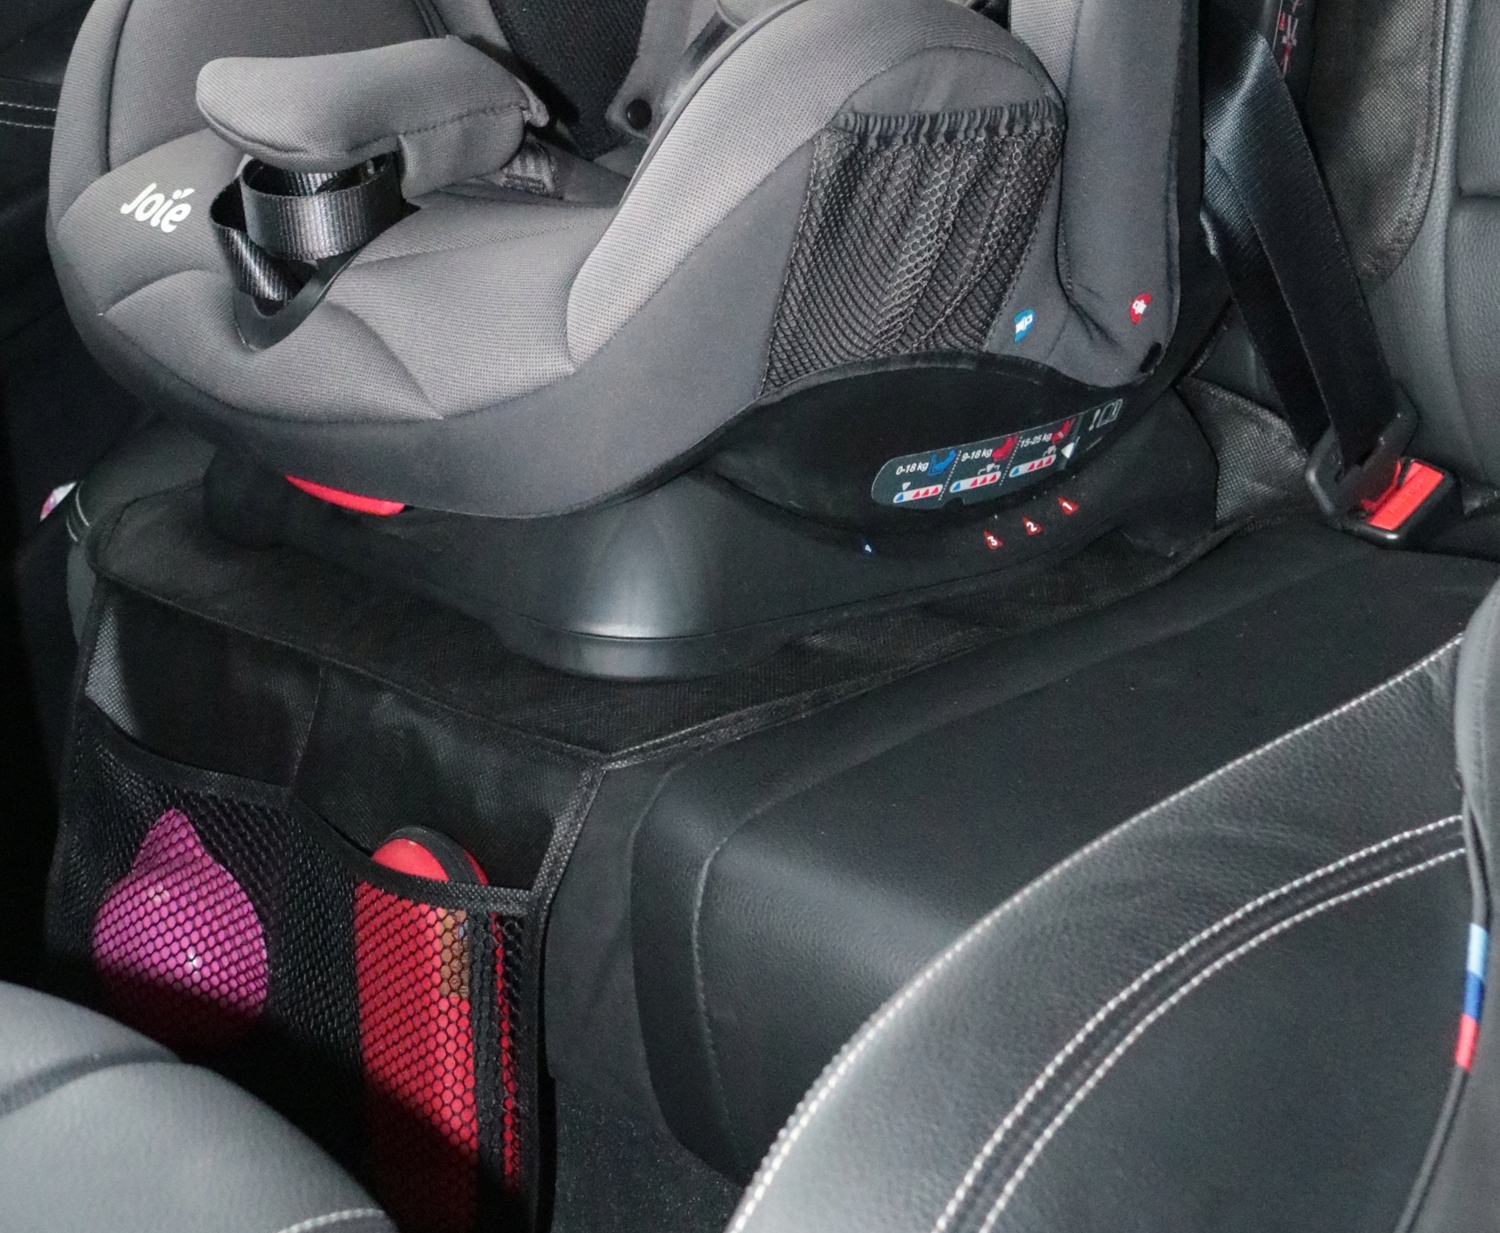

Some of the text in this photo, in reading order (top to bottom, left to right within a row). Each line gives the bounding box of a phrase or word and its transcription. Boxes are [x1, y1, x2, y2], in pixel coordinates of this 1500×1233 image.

[120, 182, 195, 233] Joie
[1042, 433, 1053, 443] kg
[961, 448, 993, 462] 9-18 kg
[896, 462, 930, 475] 0-18 kg
[1062, 501, 1073, 511] 1
[1026, 521, 1037, 532] 2
[987, 535, 998, 546] 3
